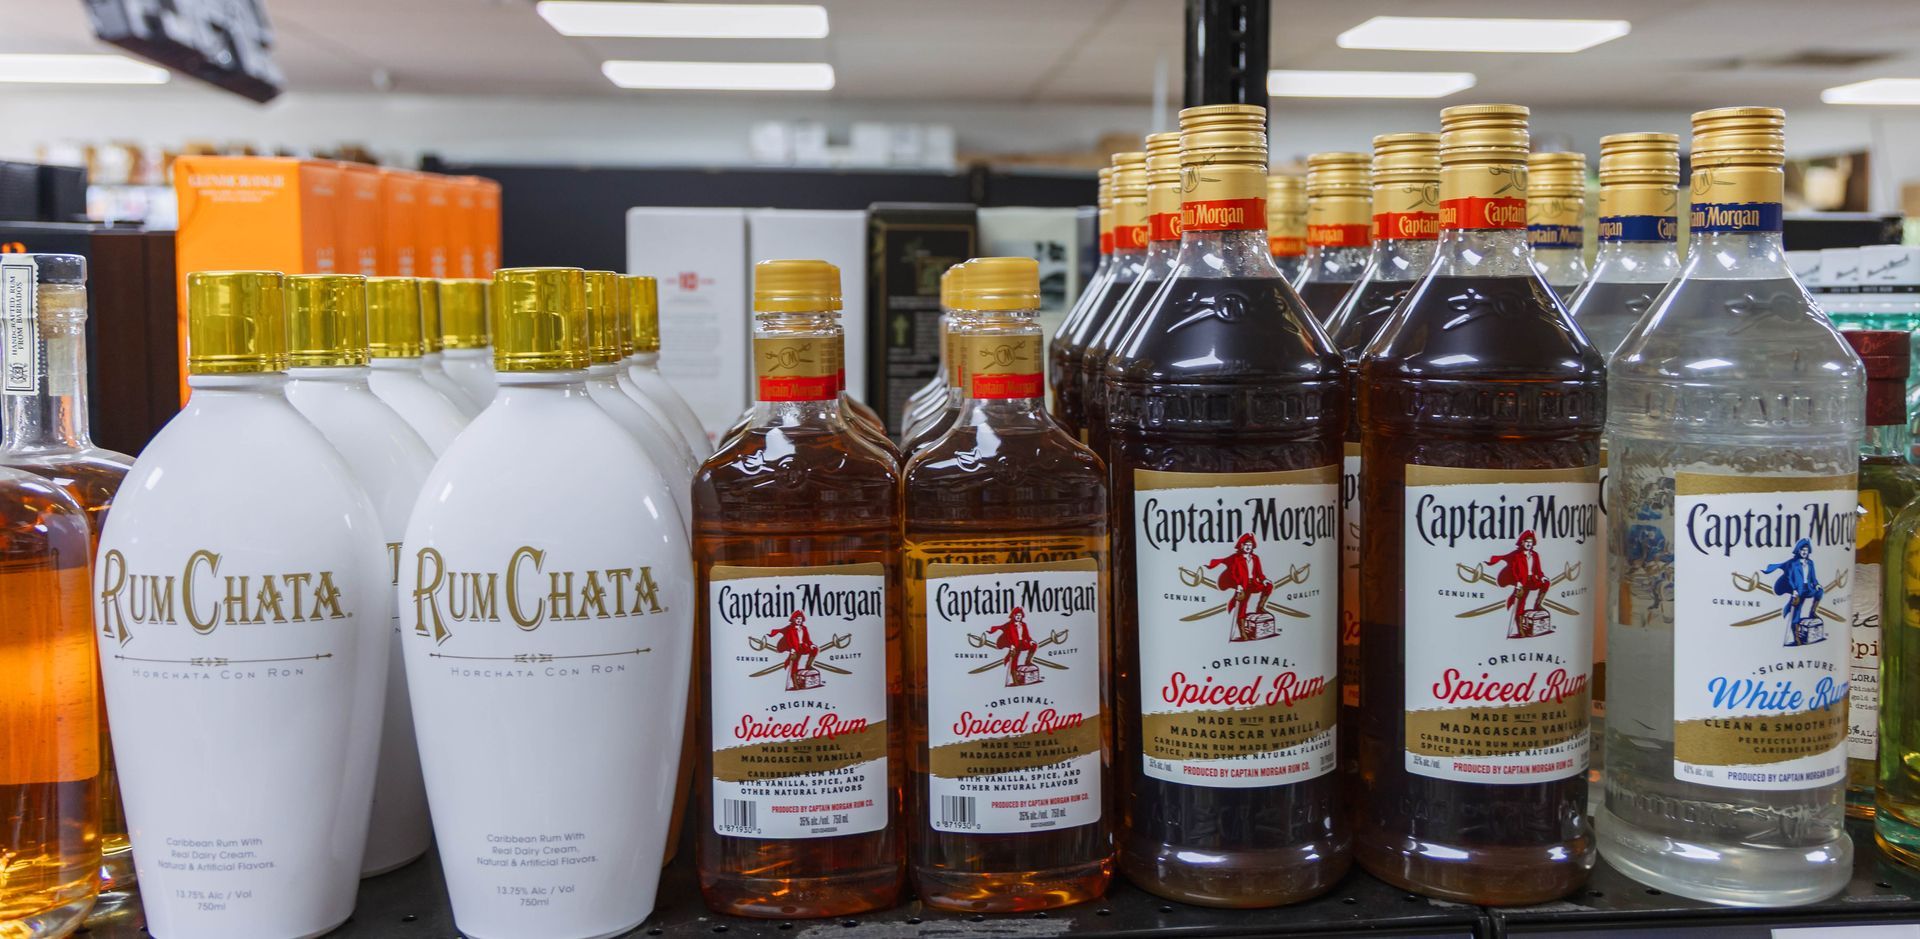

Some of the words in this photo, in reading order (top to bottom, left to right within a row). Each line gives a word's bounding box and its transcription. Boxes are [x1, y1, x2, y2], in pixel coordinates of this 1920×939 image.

[1195, 204, 1244, 226] Morgan
[1705, 207, 1760, 229] Morgan
[1143, 498, 1242, 552] Captain
[1245, 498, 1335, 546] Morgan
[1416, 494, 1524, 548] Captain
[1686, 503, 1800, 556] Captain
[1804, 503, 1855, 551] Morg
[1164, 593, 1206, 603] GENUINE
[1287, 589, 1321, 601] QUALITY
[1438, 589, 1485, 599] GENUINE
[1561, 587, 1587, 598] QUALITY
[718, 584, 795, 625] Captain
[796, 583, 882, 621] Morgan
[936, 582, 1014, 622] Captain
[1016, 580, 1096, 616] Morgan
[1712, 598, 1761, 607] GENUINE
[829, 653, 862, 661] QUALITY
[1048, 648, 1078, 656] QUALITY
[1211, 656, 1289, 669] ORIGINAL
[1488, 652, 1561, 666] ORIGINAL
[220, 663, 256, 680] CON
[268, 668, 304, 678] RON
[451, 667, 534, 678] HORCHATA
[545, 667, 580, 678] CON
[592, 664, 626, 674] RON
[1759, 660, 1834, 675] SIGNATURE
[1162, 671, 1263, 707] Spiced
[1266, 671, 1325, 707] Rum
[1432, 668, 1537, 704] Spiced
[1539, 668, 1587, 704] Rum
[1707, 676, 1804, 710] White
[771, 700, 830, 712] ORIGINAL
[991, 696, 1048, 708] ORIGINAL
[1197, 716, 1233, 726] MADE
[1239, 716, 1264, 724] WITH
[1270, 712, 1299, 724] REAL
[1470, 712, 1508, 722] MADE
[1542, 710, 1567, 720] REAL
[734, 714, 811, 741] Spiced
[813, 713, 868, 740] Rum
[953, 711, 1029, 738] Spiced
[1031, 708, 1083, 735] Rum
[1440, 722, 1537, 736] MADAGASCAR
[1542, 718, 1587, 734] VANILLA
[1705, 719, 1753, 731] CLEAN
[1760, 723, 1768, 732] &
[1775, 720, 1825, 732] SMOOTH
[1170, 725, 1265, 740] MADAGASCAR
[1271, 721, 1321, 738] VANILLA
[981, 741, 1009, 749] MADE
[1154, 736, 1208, 751] CARIBBEAN
[1239, 743, 1268, 752] MADE
[1421, 733, 1481, 747] CARIBBEAN
[1485, 740, 1508, 748] RUM
[1738, 736, 1797, 744] PERFECTLY
[762, 745, 788, 753] MADE
[960, 751, 1032, 759] MADAGASCAR
[1036, 745, 1079, 758] VANILLA
[1154, 745, 1184, 757] SPICE,
[1189, 751, 1209, 760] AND
[1253, 749, 1298, 760] NATURAL
[1300, 739, 1331, 754] FLAVORS
[1421, 742, 1454, 753] SPICE,
[1459, 748, 1482, 757] AND
[1486, 749, 1521, 757] OTHER
[1525, 746, 1564, 757] NATURAL
[741, 755, 812, 763] MADAGASCAR
[817, 752, 863, 763] VANILLA
[829, 767, 855, 776] MADE
[1047, 762, 1072, 771] MADE
[1183, 765, 1218, 778] PRODUCED
[1220, 767, 1229, 777] BY
[1231, 767, 1259, 778] CAPTAIN
[1260, 765, 1287, 777] MORGAN
[1287, 763, 1300, 774] RUM
[1453, 762, 1491, 774] PRODUCED
[1493, 764, 1501, 774] BY
[1503, 764, 1530, 774] CAPTAIN
[1531, 763, 1555, 773] MORGAN
[1556, 761, 1567, 770] RUM
[765, 779, 808, 787] VANILLA,
[812, 777, 843, 786] SPICE,
[846, 774, 865, 782] AND
[1031, 772, 1060, 781] SPICE,
[1064, 769, 1081, 777] AND
[1727, 771, 1766, 782] PRODUCED
[1767, 772, 1777, 782] BY
[1778, 771, 1804, 782] CAPTAIN
[1805, 770, 1826, 781] MORGAN
[741, 788, 770, 796] OTHER
[774, 787, 817, 795] NATURAL
[822, 784, 862, 795] FLAVORS
[994, 783, 1037, 791] NATURAL
[1040, 778, 1079, 790] FLAVORS
[772, 805, 799, 814] PRODUCED
[808, 805, 830, 813] CAPTAIN
[831, 803, 853, 811] MORGAN
[1028, 799, 1049, 808] CAPTAIN
[487, 834, 536, 844] Caribbean
[540, 834, 562, 842] Rum
[564, 832, 585, 841] With
[515, 846, 540, 856] Dairy
[477, 857, 508, 866] Natural
[520, 858, 558, 867] Artificial
[531, 886, 546, 895] Alc
[559, 885, 575, 893] Vol
